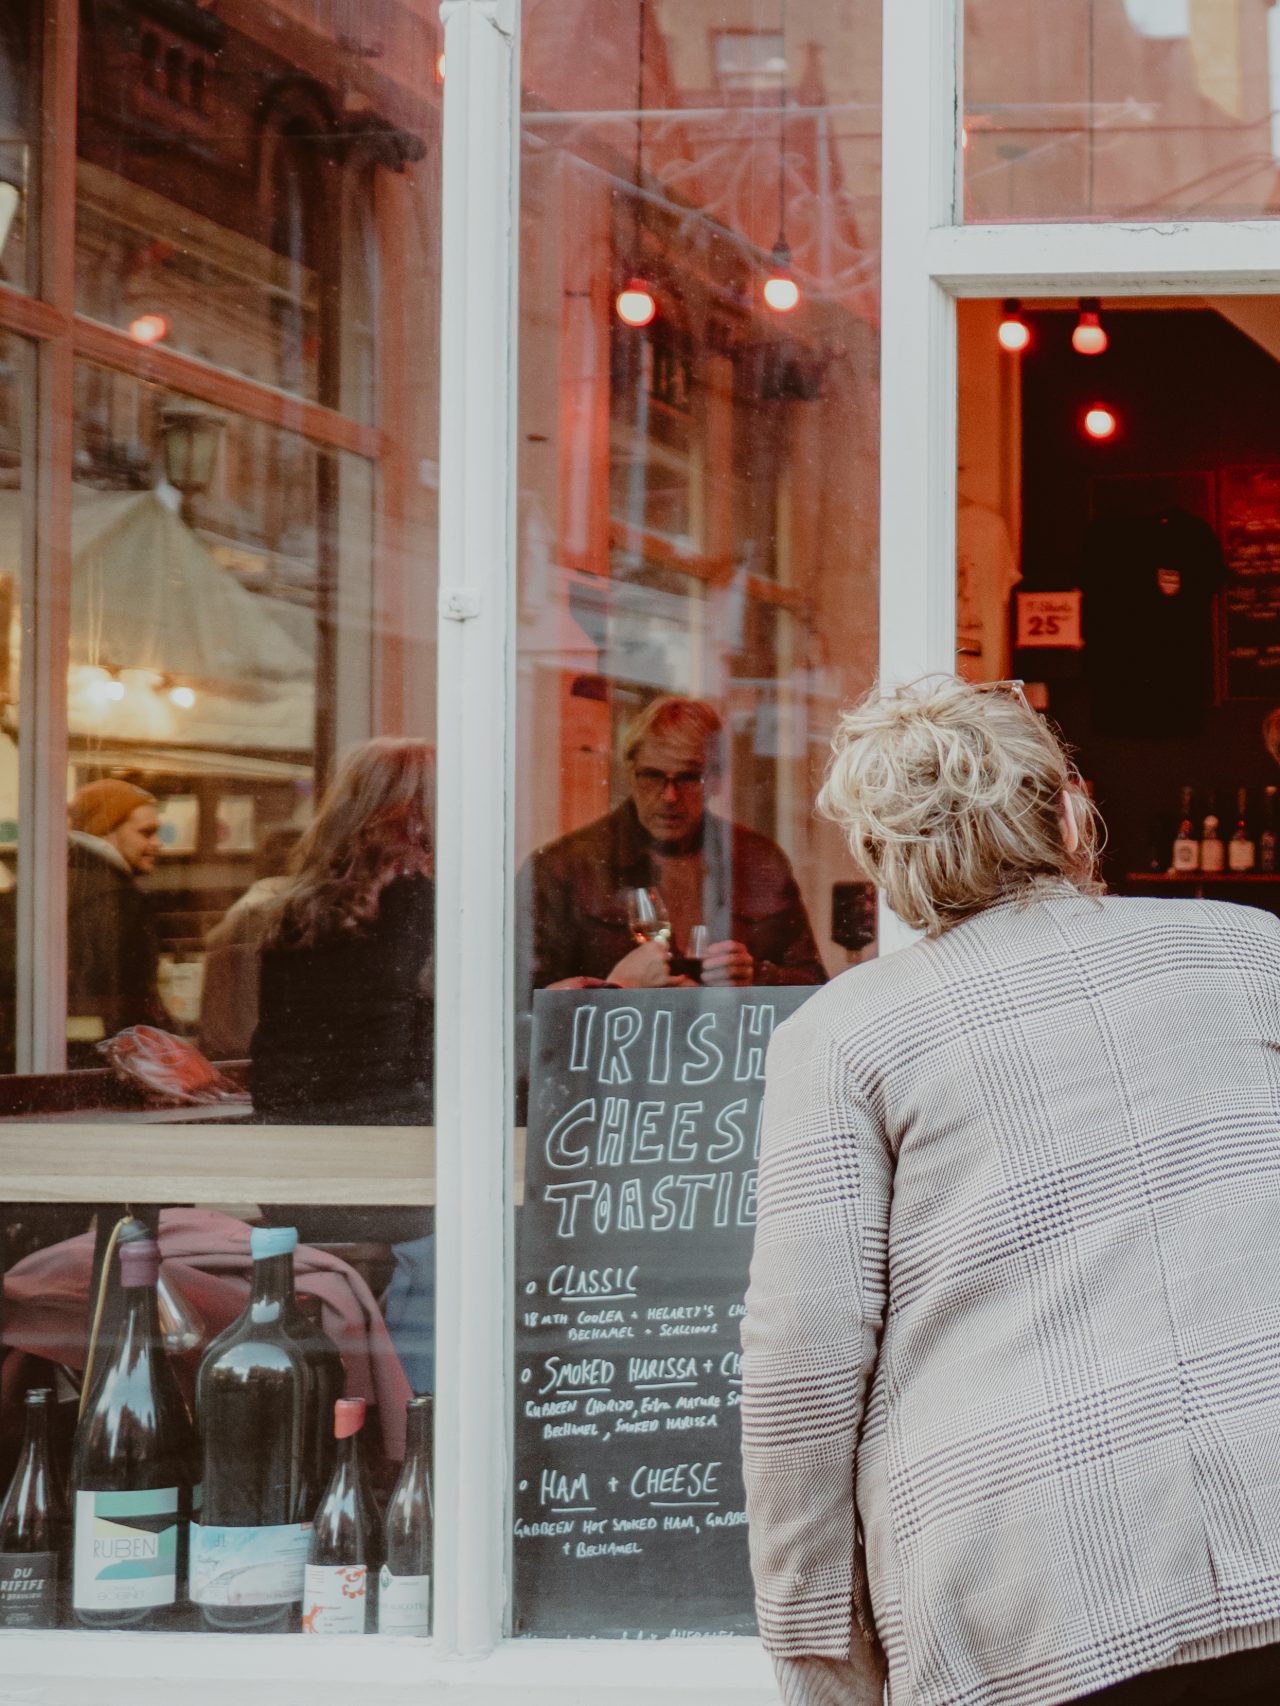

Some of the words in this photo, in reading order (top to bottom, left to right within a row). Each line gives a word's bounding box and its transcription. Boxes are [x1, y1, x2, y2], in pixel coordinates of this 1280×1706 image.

[569, 1004, 774, 1085] IRISH
[545, 1096, 765, 1169] CHEES
[549, 1264, 639, 1296] CLASSIC
[524, 1311, 539, 1327] 18
[568, 1326, 635, 1341] BECHAMEL
[538, 1356, 615, 1395] SMOKED
[628, 1357, 698, 1383] HARISSA
[665, 1414, 718, 1430] HARISSA
[540, 1468, 589, 1505] HAM
[630, 1461, 722, 1498] CHEESE
[514, 1517, 575, 1538] GUBBEEN
[612, 1517, 657, 1531] SMOKED
[93, 1537, 156, 1559] RUBEN
[575, 1541, 643, 1559] BECHAMEL
[13, 1567, 33, 1579] DU
